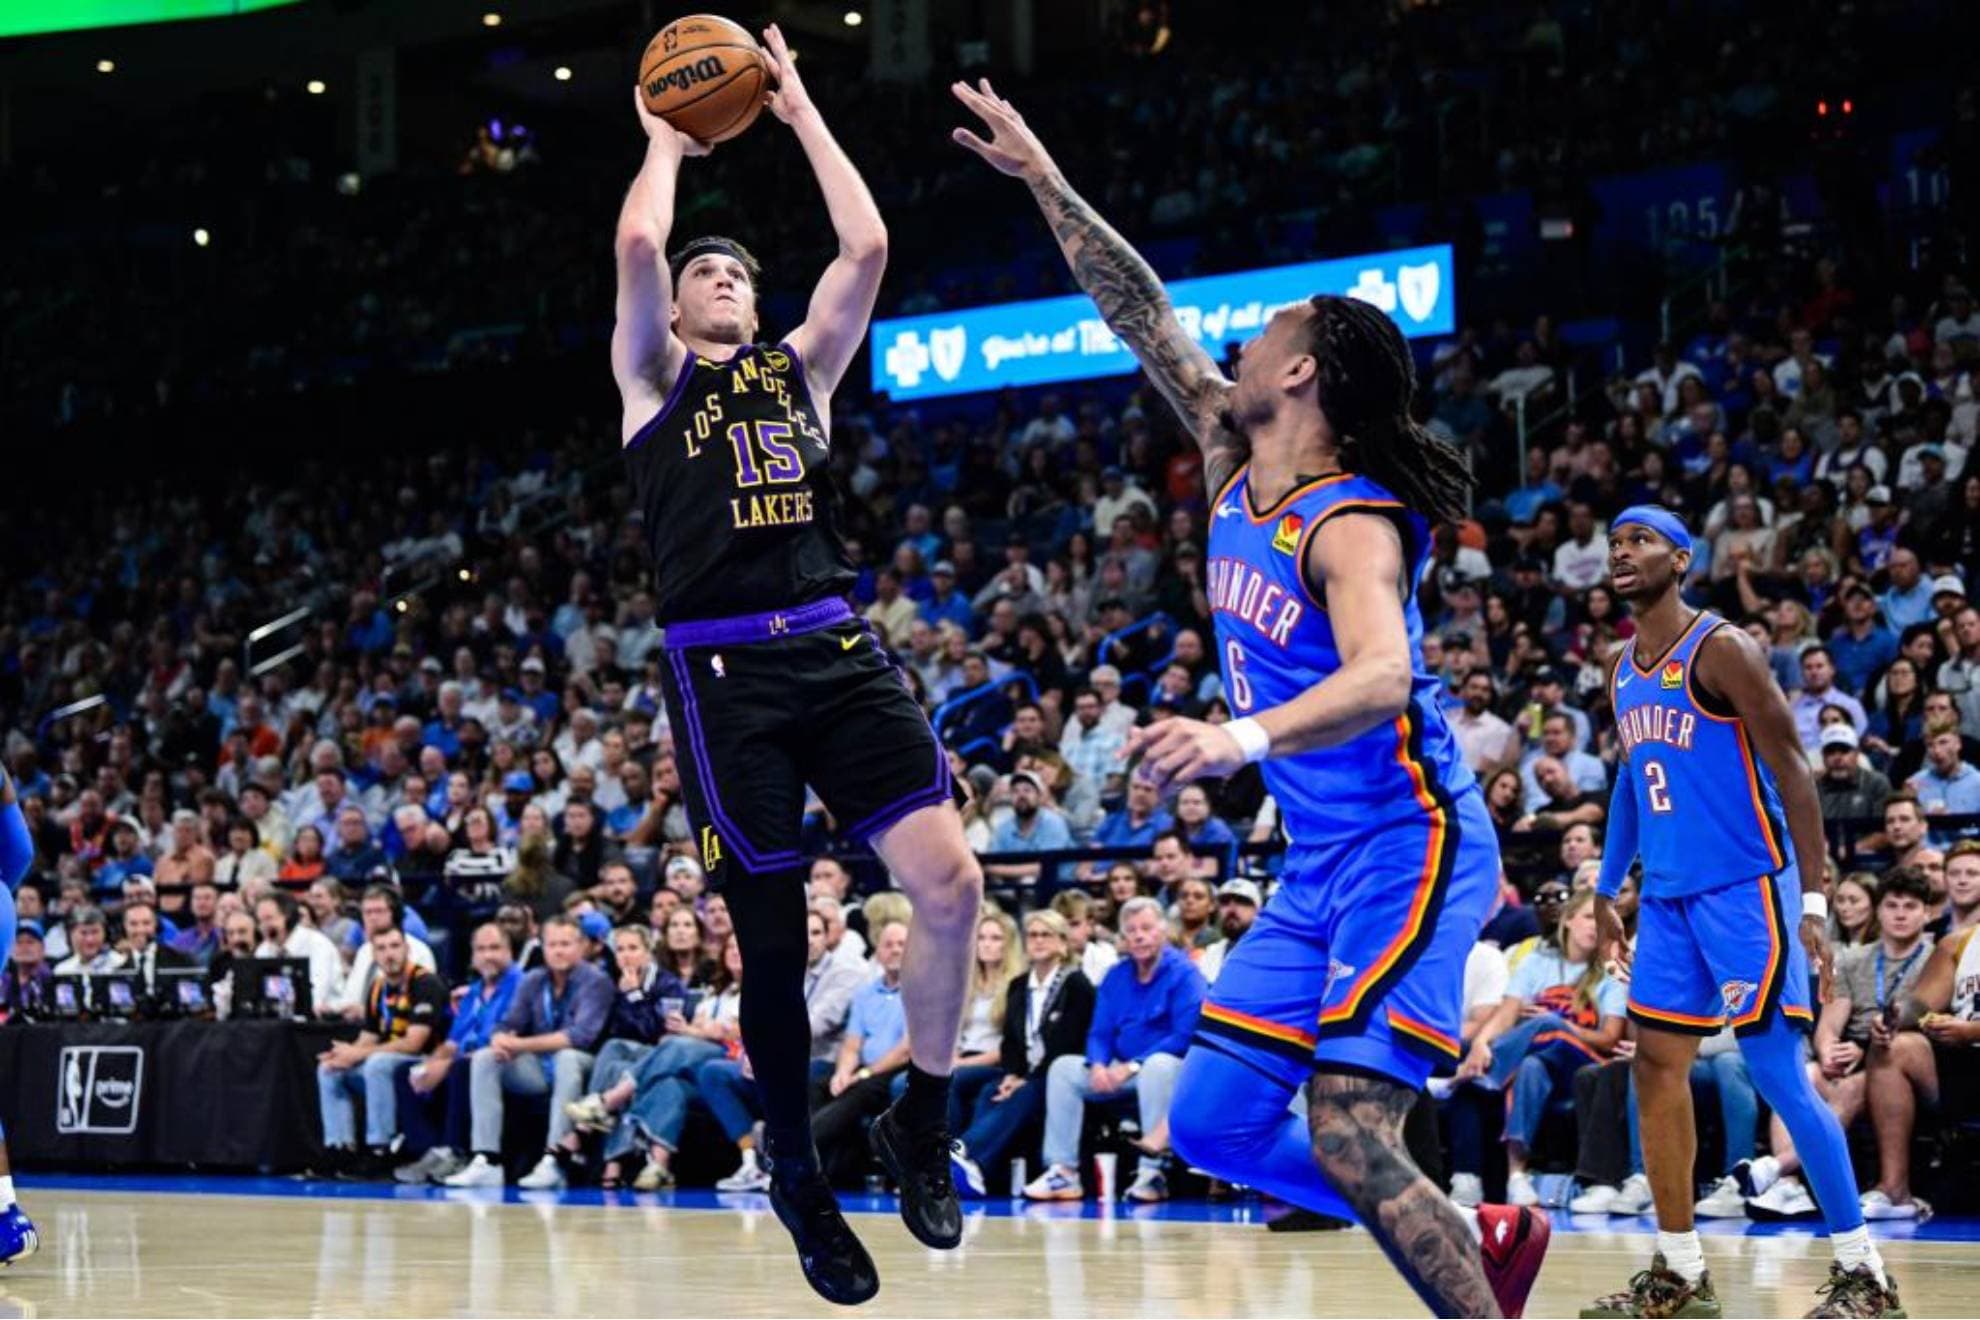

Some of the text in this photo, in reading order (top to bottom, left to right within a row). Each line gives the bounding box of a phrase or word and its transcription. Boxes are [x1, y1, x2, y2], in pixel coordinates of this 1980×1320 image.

[646, 55, 727, 98] Wilson
[683, 392, 724, 459] LOS
[726, 419, 806, 489] 15
[730, 490, 814, 529] LAKERS
[1227, 639, 1252, 711] 6
[1644, 760, 1672, 812] 2
[95, 1077, 133, 1097] prime
